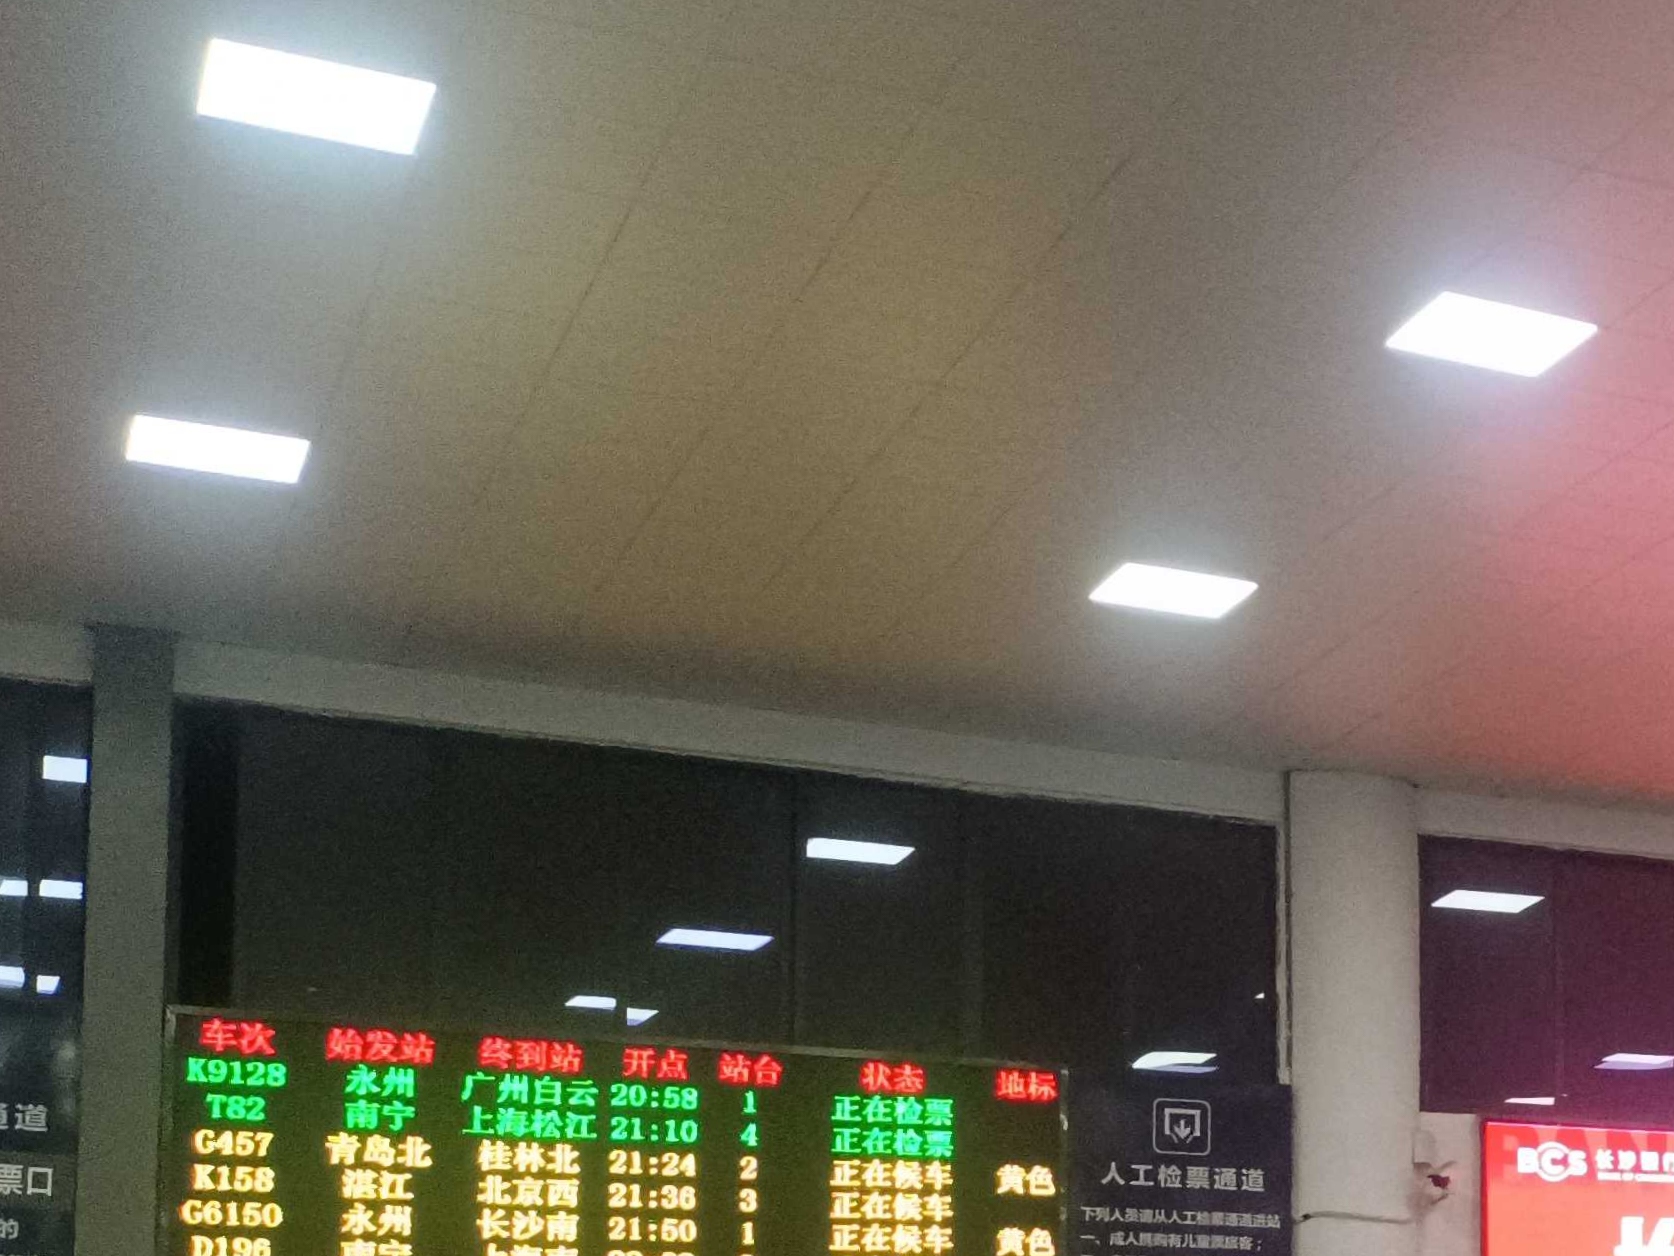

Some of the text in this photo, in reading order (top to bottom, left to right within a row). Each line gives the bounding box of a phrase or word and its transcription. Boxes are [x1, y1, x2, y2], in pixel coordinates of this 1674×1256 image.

[204, 1019, 1057, 1099] 车次 始发站 终到站 开点 站台 状态 地标
[0, 1104, 48, 1132] 道
[187, 1058, 953, 1126] K9128 永州 广州白云 20:58 1 正在检票
[206, 1094, 953, 1156] T82 南宁 上海松江 21:10 4 正在检票
[194, 1129, 1055, 1195] G457 青岛北 桂林北 21:24 2 正在候车 黄色
[1101, 1161, 1265, 1192] 人工检票通道
[1517, 1141, 1588, 1182] BCS
[193, 1165, 953, 1221] K158 湛江 北京西 21:36 3 正在候车
[181, 1201, 283, 1227] G6150
[341, 1204, 412, 1236] 永州
[477, 1211, 579, 1241] 长沙南
[608, 1217, 696, 1242] 21:50
[742, 1222, 755, 1245] 1
[830, 1225, 953, 1253] 正在候车
